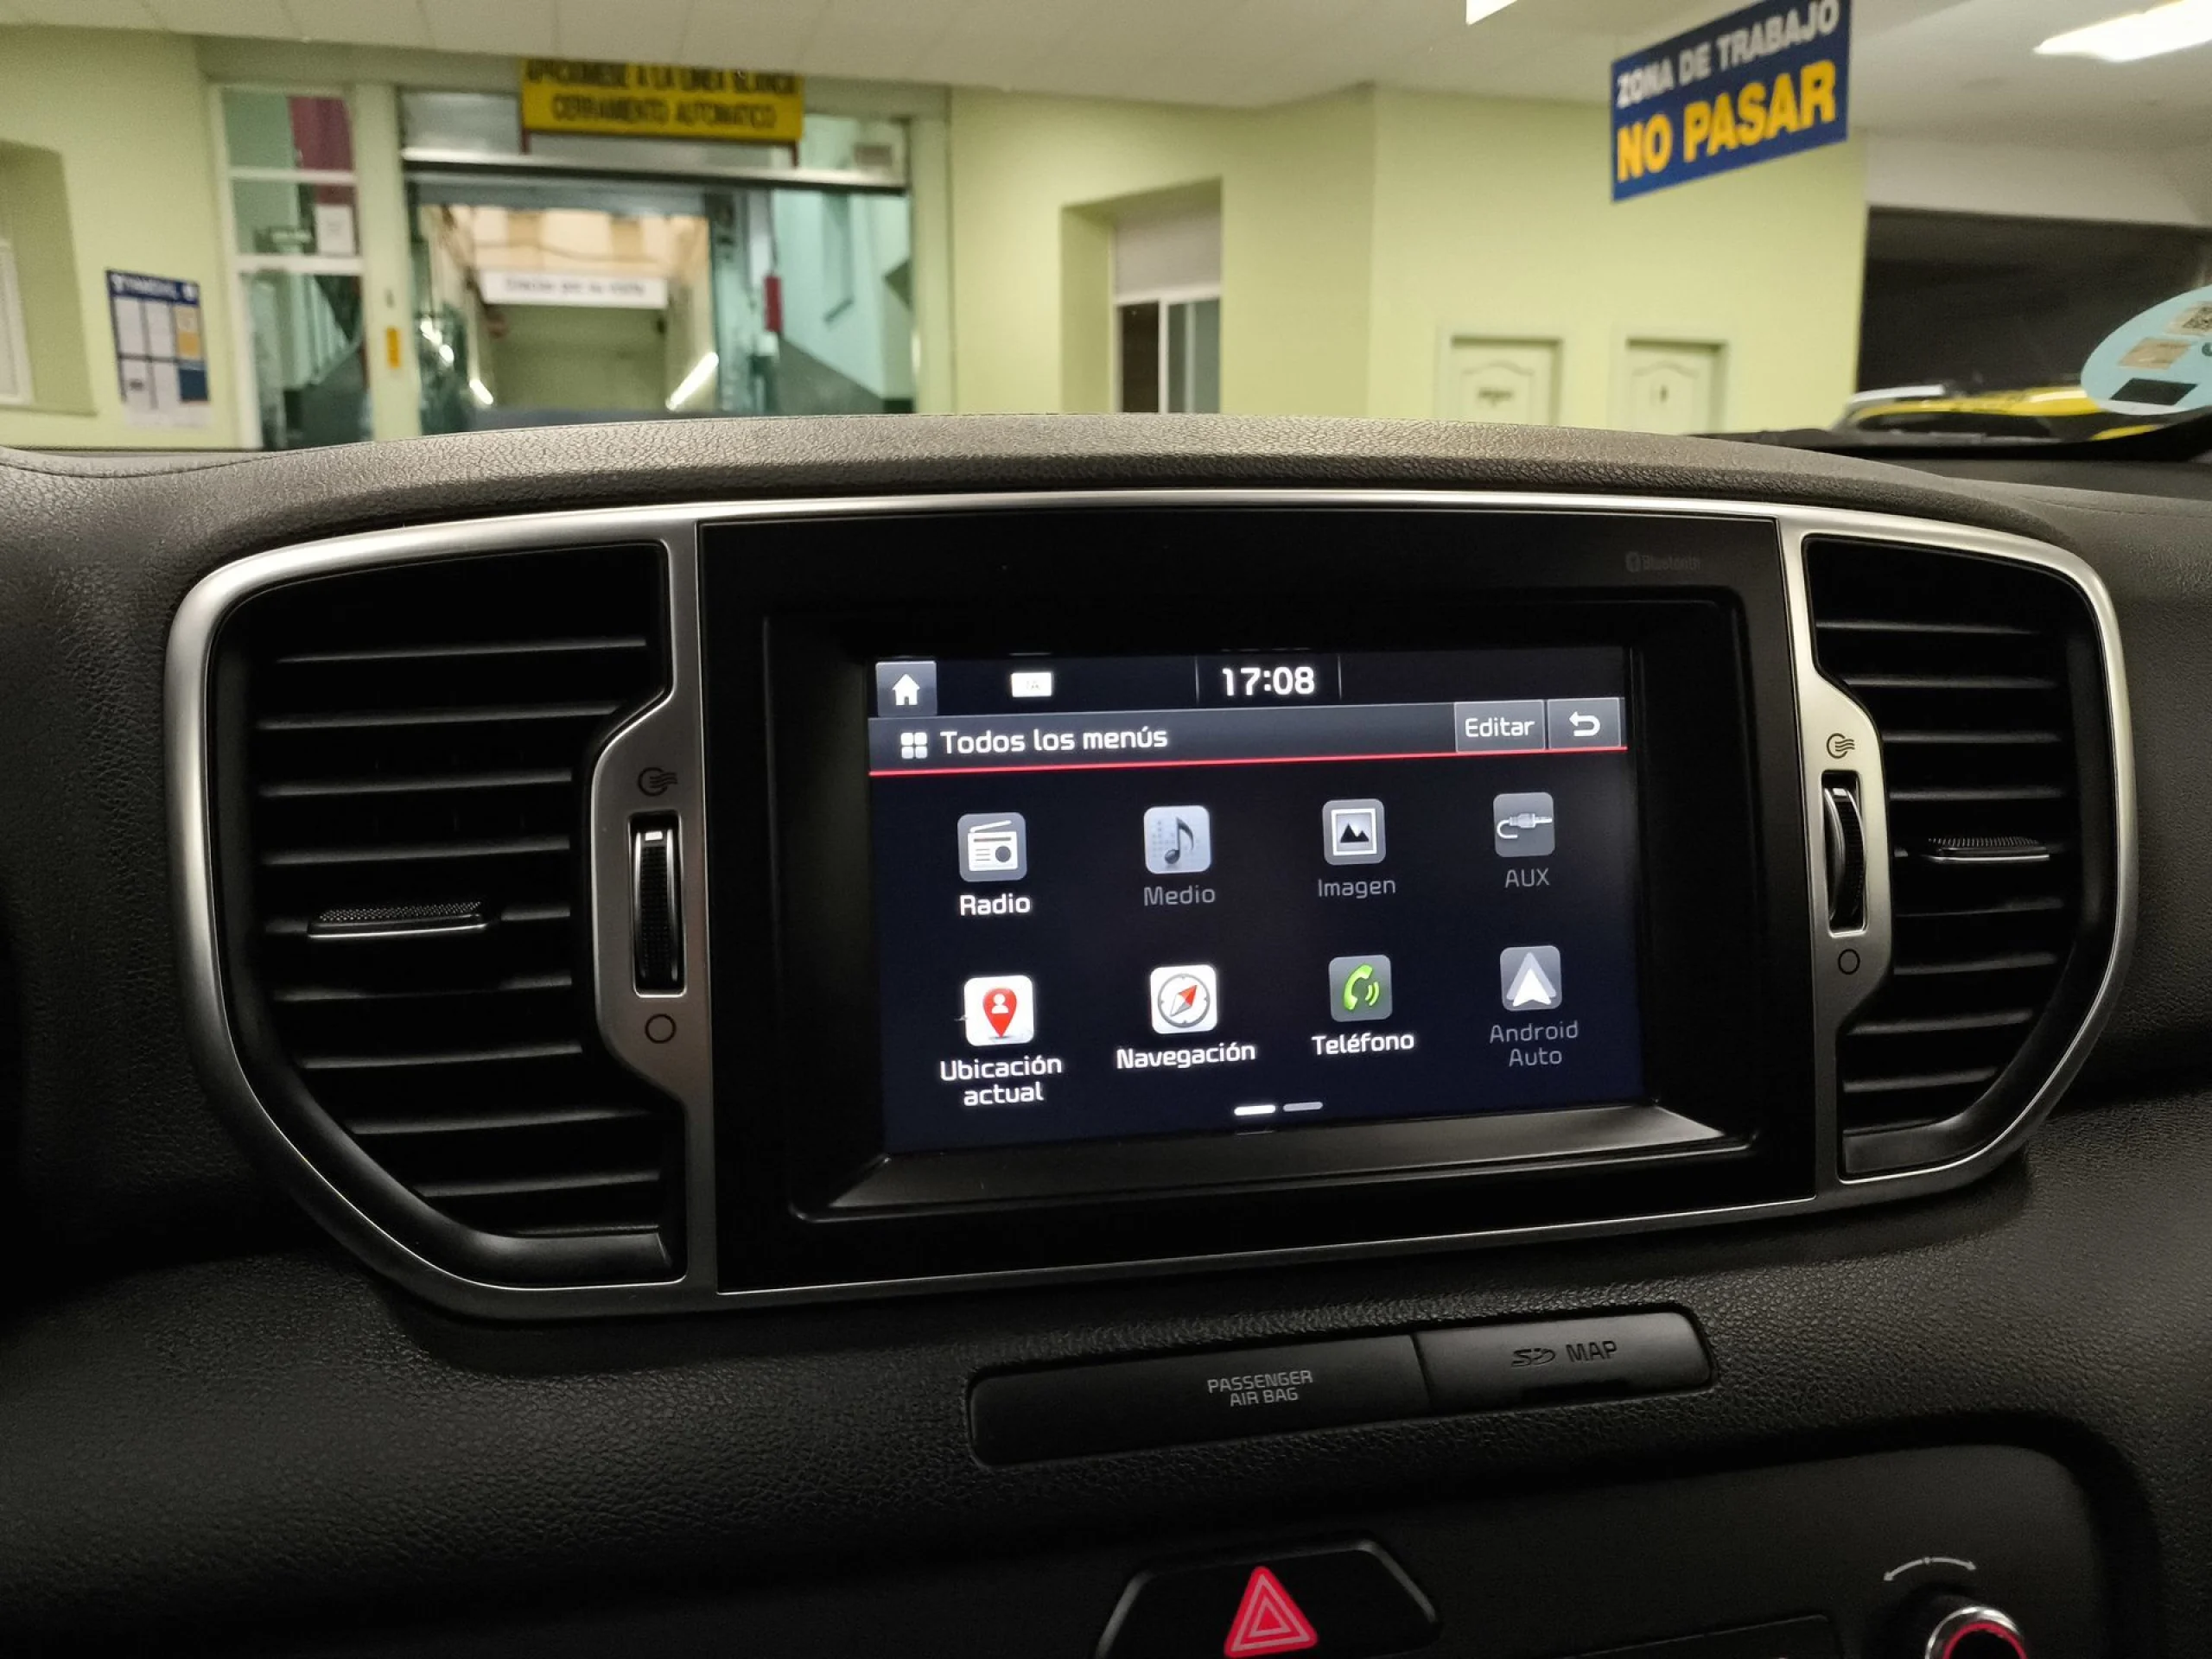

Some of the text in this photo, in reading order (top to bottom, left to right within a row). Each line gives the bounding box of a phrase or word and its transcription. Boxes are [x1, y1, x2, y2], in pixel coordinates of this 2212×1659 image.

[1616, 0, 1840, 109] ZONA DE TRABAJO
[1616, 59, 1837, 183] NO PASAR
[1222, 666, 1315, 696] 17:08
[940, 725, 1168, 754] Todos los menús
[1465, 717, 1535, 739] Editar
[1318, 877, 1396, 899] Imagen
[1504, 867, 1551, 889] AUX
[959, 893, 1032, 917] Radio
[1143, 886, 1217, 906] Medio
[1312, 1031, 1415, 1056] Teléfono
[1489, 1020, 1580, 1045] Android
[1116, 1042, 1257, 1071] Navegación
[1508, 1046, 1563, 1068] Auto
[939, 1055, 1063, 1083] Ubicación
[963, 1080, 1045, 1107] actual
[1565, 1340, 1618, 1363] MAP
[1206, 1370, 1313, 1394] PASSENGER
[1230, 1386, 1299, 1408] AIR BAG
